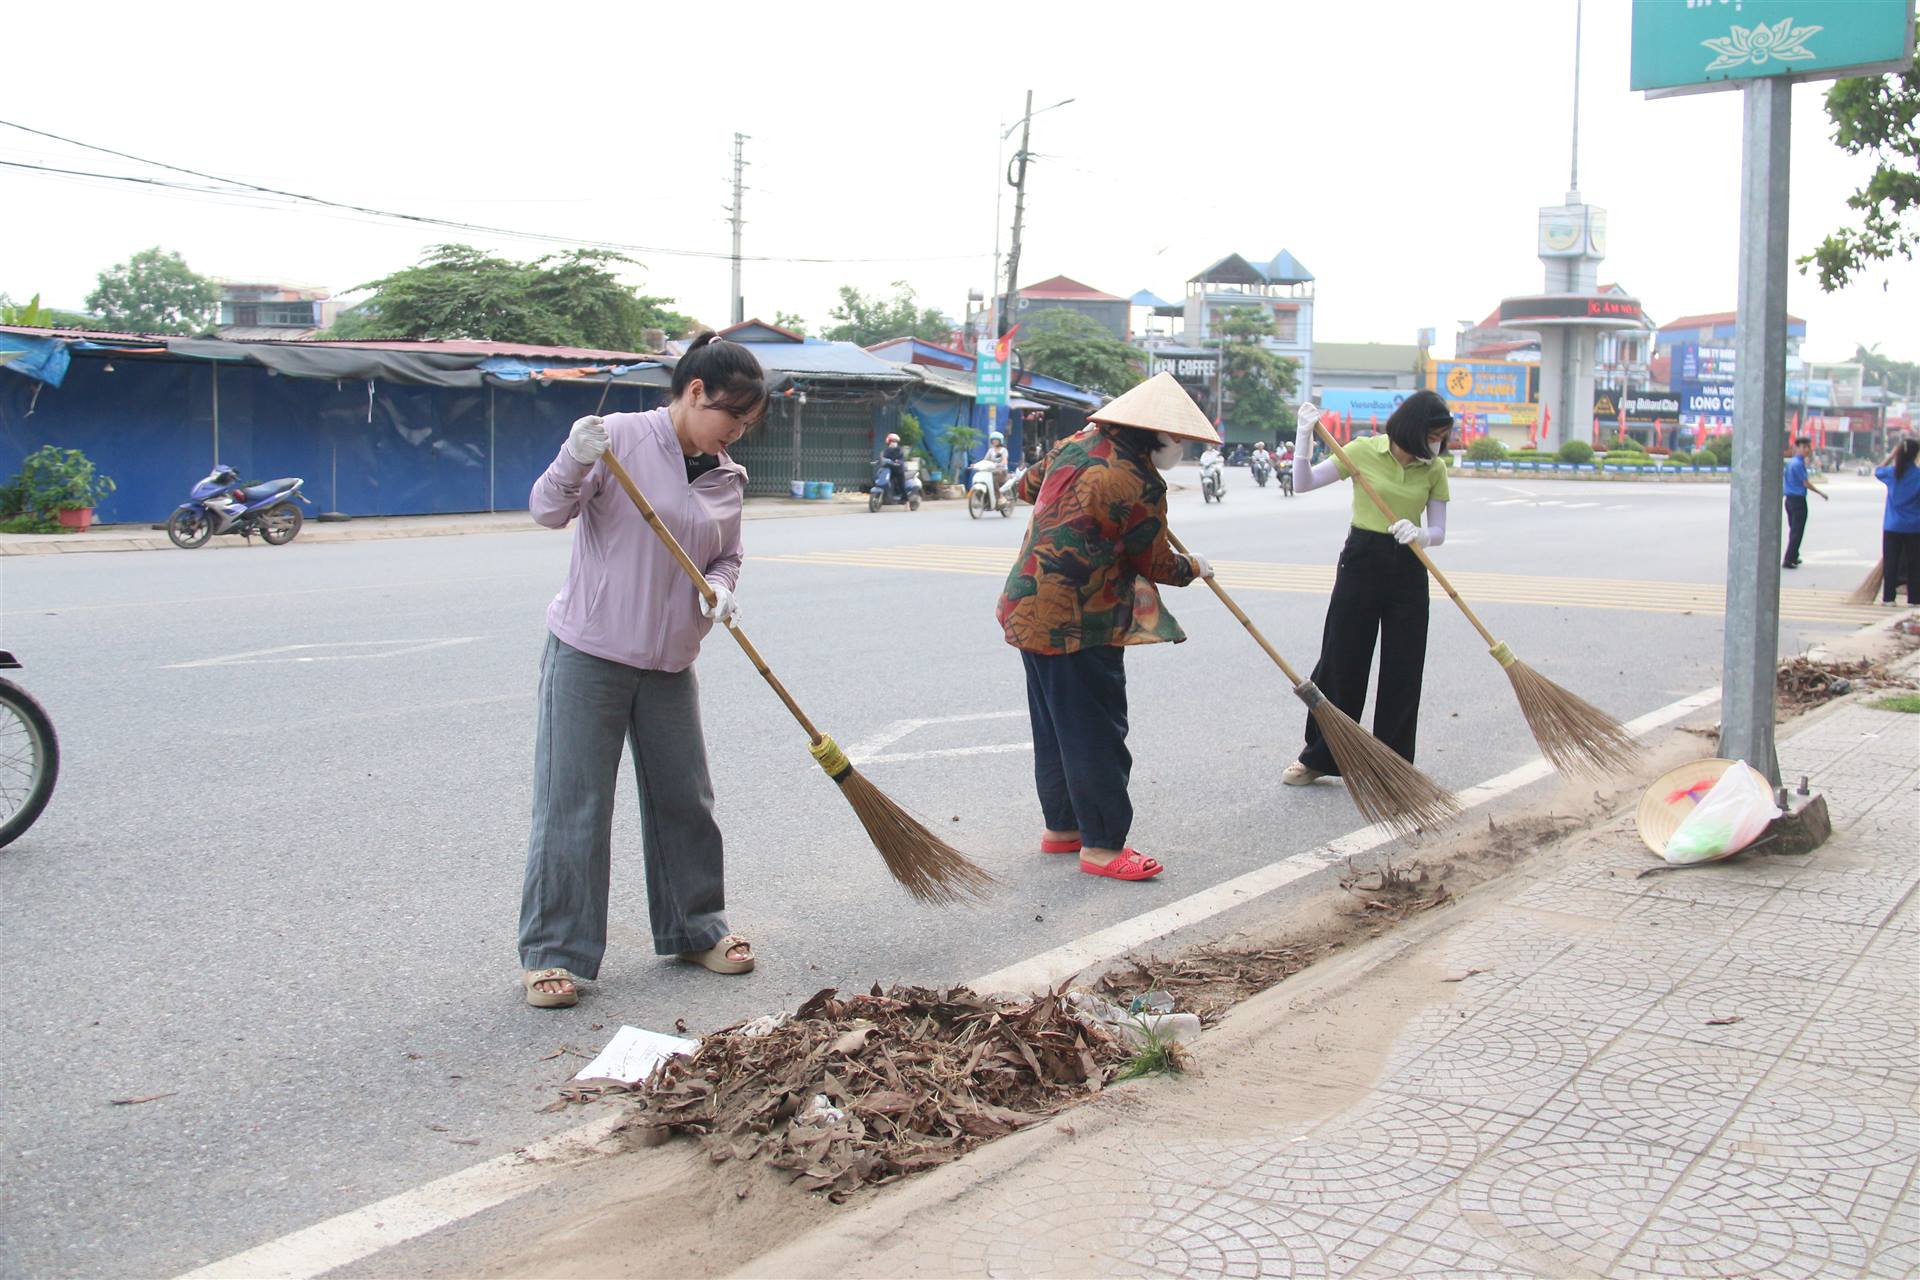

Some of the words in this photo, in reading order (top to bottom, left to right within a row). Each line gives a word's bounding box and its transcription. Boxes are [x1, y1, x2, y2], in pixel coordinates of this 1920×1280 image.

[1178, 359, 1217, 376] COFFEE
[1662, 398, 1679, 411] Club
[1689, 395, 1721, 411] LONG
